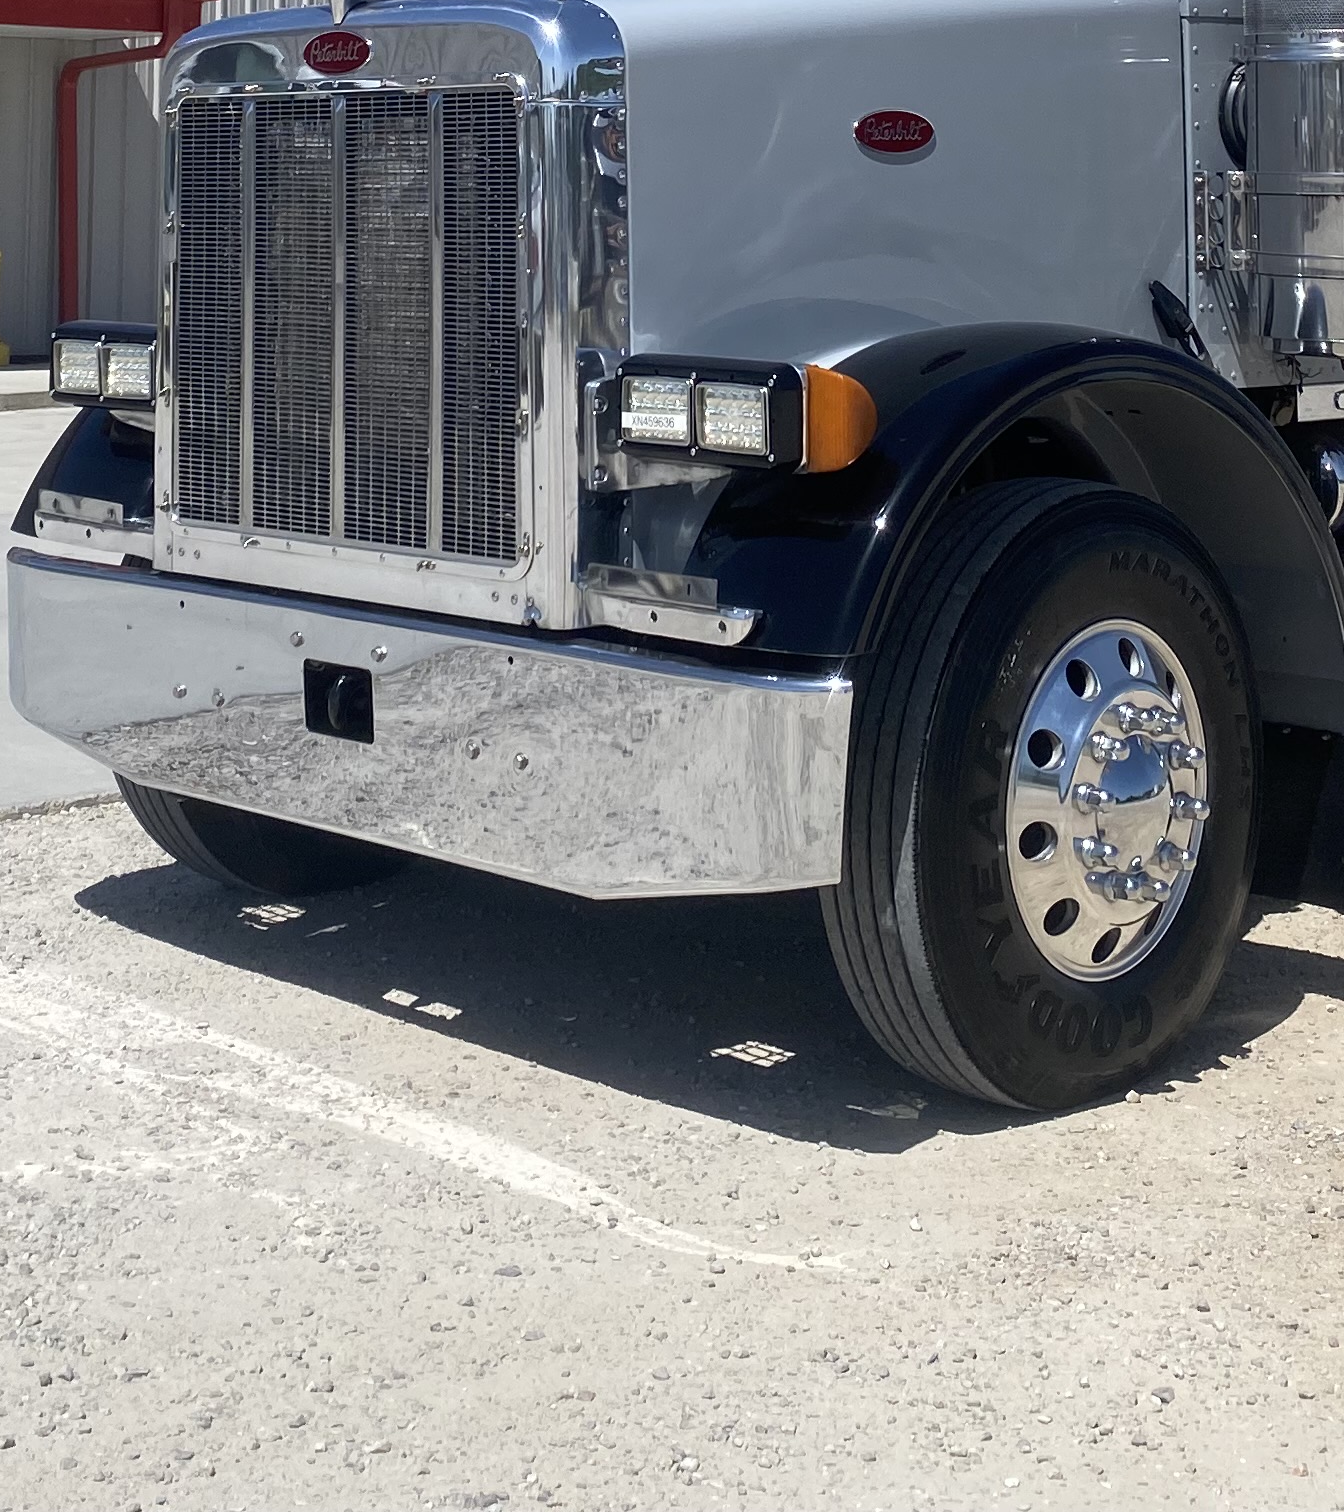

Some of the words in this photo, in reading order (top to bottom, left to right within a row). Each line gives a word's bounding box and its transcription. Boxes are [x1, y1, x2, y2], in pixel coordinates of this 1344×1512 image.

[310, 38, 364, 66] Peterbilt
[863, 117, 928, 143] Peterbilt
[1108, 550, 1241, 689] MARATHON
